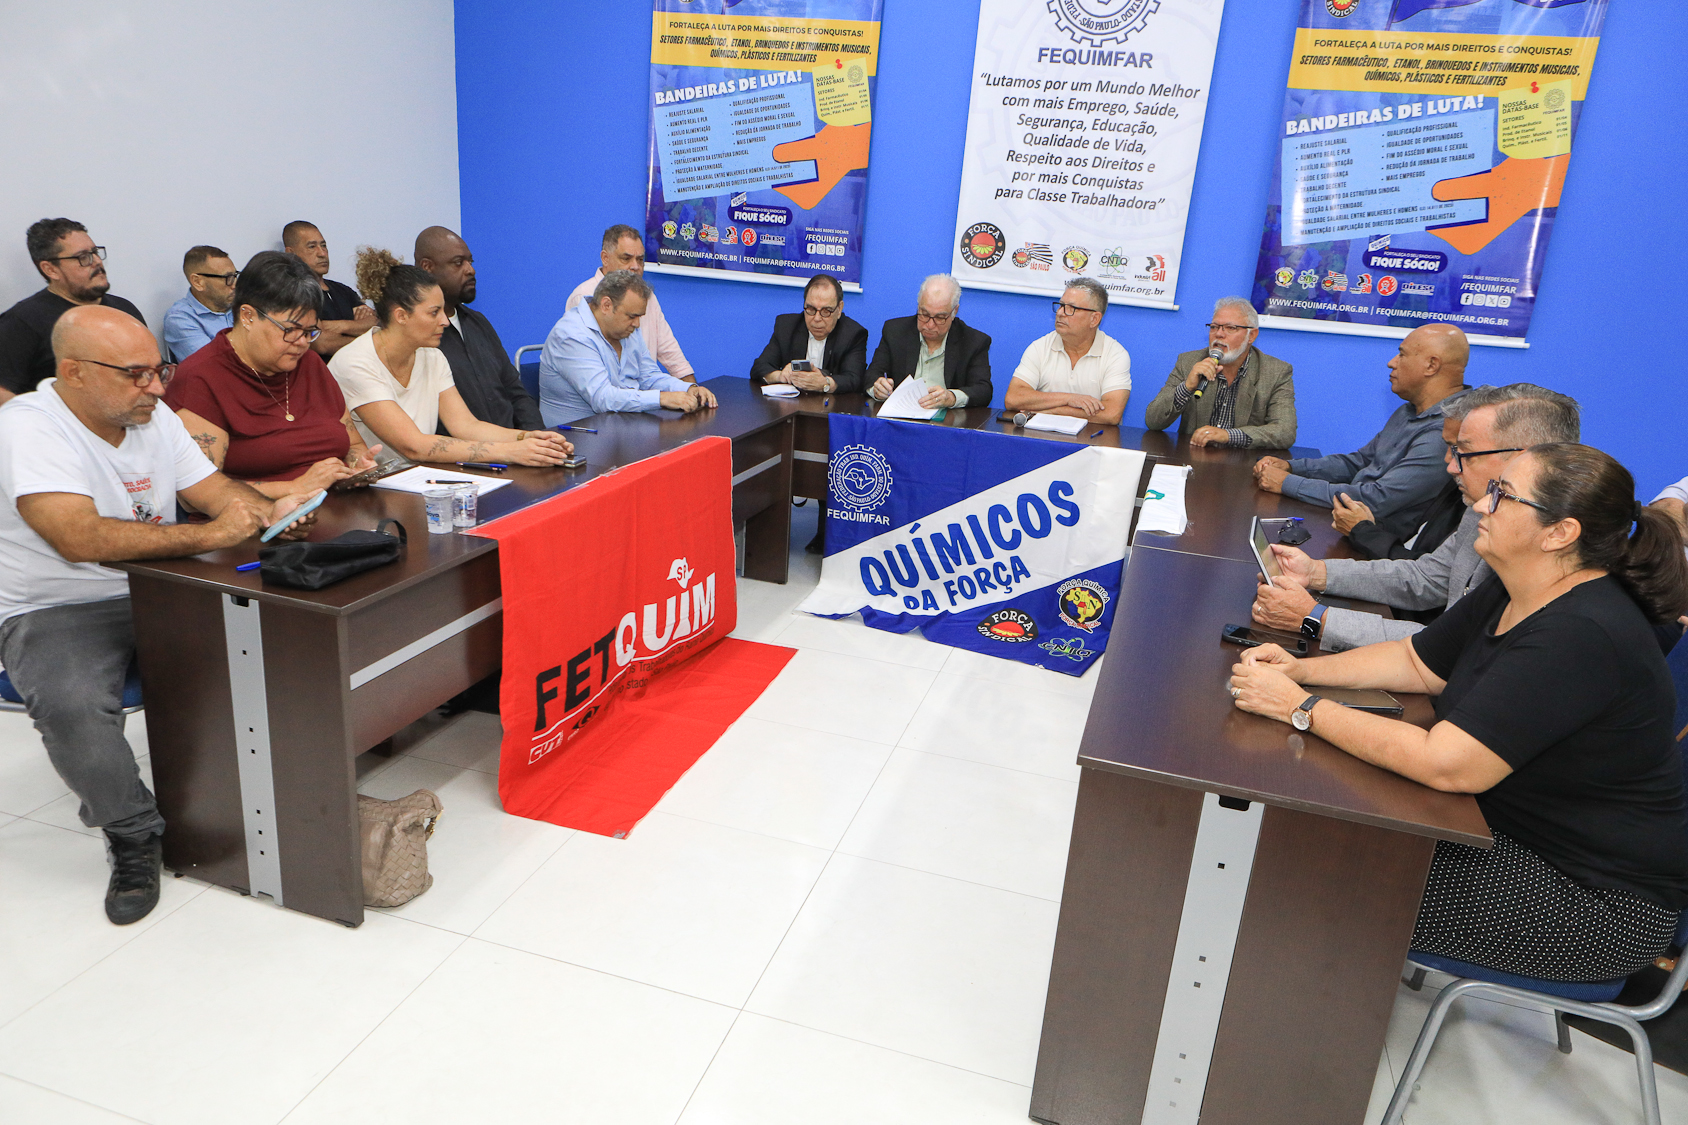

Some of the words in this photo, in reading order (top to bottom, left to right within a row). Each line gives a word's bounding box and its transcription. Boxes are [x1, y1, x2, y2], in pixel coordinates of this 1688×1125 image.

[1327, 1, 1358, 16] SINDICAL
[669, 21, 709, 31] FORTALEÇA
[772, 26, 805, 34] DIREITOS
[813, 28, 864, 37] CONQUISTAS!
[659, 35, 684, 44] SETORES
[684, 34, 728, 48] FARMACÊUTICO,
[730, 38, 754, 50] ETANOL,
[754, 40, 789, 50] BRINQUEDOS
[790, 41, 794, 50] E
[794, 42, 839, 52] INSTRUMENTOS
[839, 44, 872, 56] MUSICAIS,
[1313, 40, 1368, 50] FORTALEÇA
[1378, 42, 1402, 50] LUTA
[1404, 43, 1424, 51] POR
[1425, 43, 1450, 52] MAIS
[1451, 44, 1496, 53] DIREITOS
[1506, 46, 1572, 56] CONQUISTAS!
[709, 49, 740, 60] QUÍMICOS,
[739, 50, 770, 61] PLÁSTICOS
[770, 53, 775, 61] E
[775, 53, 817, 63] FERTILIZANTES
[1038, 48, 1153, 68] FEQUIMFAR
[1299, 55, 1331, 65] SETORES
[1331, 54, 1390, 69] FARMACÊUTICO,
[1392, 58, 1424, 71] ETANOL,
[1424, 60, 1472, 70] BRINQUEDOS
[1472, 61, 1479, 70] E
[1478, 62, 1539, 73] INSTRUMENTOS
[1539, 64, 1581, 76] MUSICAIS,
[979, 73, 1042, 89] “Lutamos
[1043, 77, 1067, 94] por
[1070, 79, 1092, 92] um
[1095, 80, 1145, 95] Mundo
[1148, 83, 1200, 99] Melhor
[1363, 69, 1403, 84] QUÍMICOS,
[1403, 71, 1445, 84] PLÁSTICOS
[1444, 74, 1451, 84] E
[1451, 74, 1507, 86] FERTILIZANTES
[655, 80, 736, 104] BANDEIRAS
[740, 76, 757, 90] DE
[760, 69, 802, 87] LUTA!
[1001, 92, 1030, 107] com
[1032, 94, 1064, 109] mais
[1067, 96, 1130, 116] Emprego,
[1134, 101, 1179, 119] Saúde,
[1502, 103, 1539, 114] DATAS-BASE
[1503, 100, 1527, 108] NOSSAS
[1286, 108, 1392, 136] BANDEIRAS
[1398, 102, 1423, 120] DE
[1427, 94, 1484, 116] LUTA!
[1503, 115, 1525, 123] SETORES
[1016, 112, 1088, 133] Segurança,
[1091, 117, 1158, 137] Educação,
[1386, 126, 1421, 138] QUALIFICAÇÃO
[1422, 122, 1457, 132] PROFISSIONAL
[1022, 132, 1090, 149] Qualidade
[1092, 137, 1110, 150] de
[1113, 139, 1147, 156] Vida,
[1300, 141, 1322, 149] REAJUSTE
[1386, 139, 1413, 148] IGUALDADE
[1422, 132, 1463, 143] OPORTUNIDADES
[1005, 149, 1063, 168] Respeito
[1064, 154, 1089, 167] aos
[1091, 156, 1144, 171] Direitos
[1146, 160, 1156, 172] e
[1404, 147, 1424, 157] ASSÉDIO
[1386, 160, 1408, 171] REDUÇÃO
[1417, 158, 1439, 166] JORNADA
[1449, 153, 1474, 162] TRABALHO
[1012, 167, 1035, 184] por
[1037, 169, 1069, 184] mais
[1071, 172, 1144, 193] Conquistas
[1399, 171, 1425, 179] EMPREGOS
[994, 184, 1024, 202] para
[1026, 186, 1068, 202] Classe
[1070, 190, 1165, 210] Trabalhadora”
[733, 211, 758, 222] FIQUE
[758, 211, 786, 224] SÓCIO!
[805, 234, 848, 244] /FEQUIMFAR
[968, 224, 1000, 240] FORÇA
[962, 246, 1004, 268] SINDICAL
[1061, 246, 1075, 254] FORÇA
[1076, 245, 1091, 257] QUÍMICA
[660, 249, 738, 261] WWW.FEQUIMFAR.ORG.BR
[744, 256, 845, 272] FEQUIMFAR@FEQUIMFAR.ORG.BR
[1100, 255, 1128, 266] CNTQ
[1369, 256, 1403, 269] FIQUE
[1402, 257, 1440, 272] SÓCIO!
[1151, 268, 1166, 282] all
[1460, 283, 1517, 294] /FEQUIMFAR
[1269, 298, 1368, 314] WWW.FEQUIMFAR.ORG.BR
[1376, 307, 1509, 326] FEQUIMFAR@FEQUIMFAR.ORG.BR
[827, 508, 890, 526] FEQUIMFAR
[859, 480, 1080, 598] QUÍMICOS
[676, 564, 687, 581] SP
[903, 588, 939, 611] DA
[946, 555, 1031, 606] FORÇA
[1057, 579, 1081, 595] FORÇA
[1082, 579, 1110, 603] QUÍMICA
[992, 610, 1034, 632] FORÇA
[978, 626, 1032, 642] SINDICAL
[534, 572, 716, 732] FETQUIM
